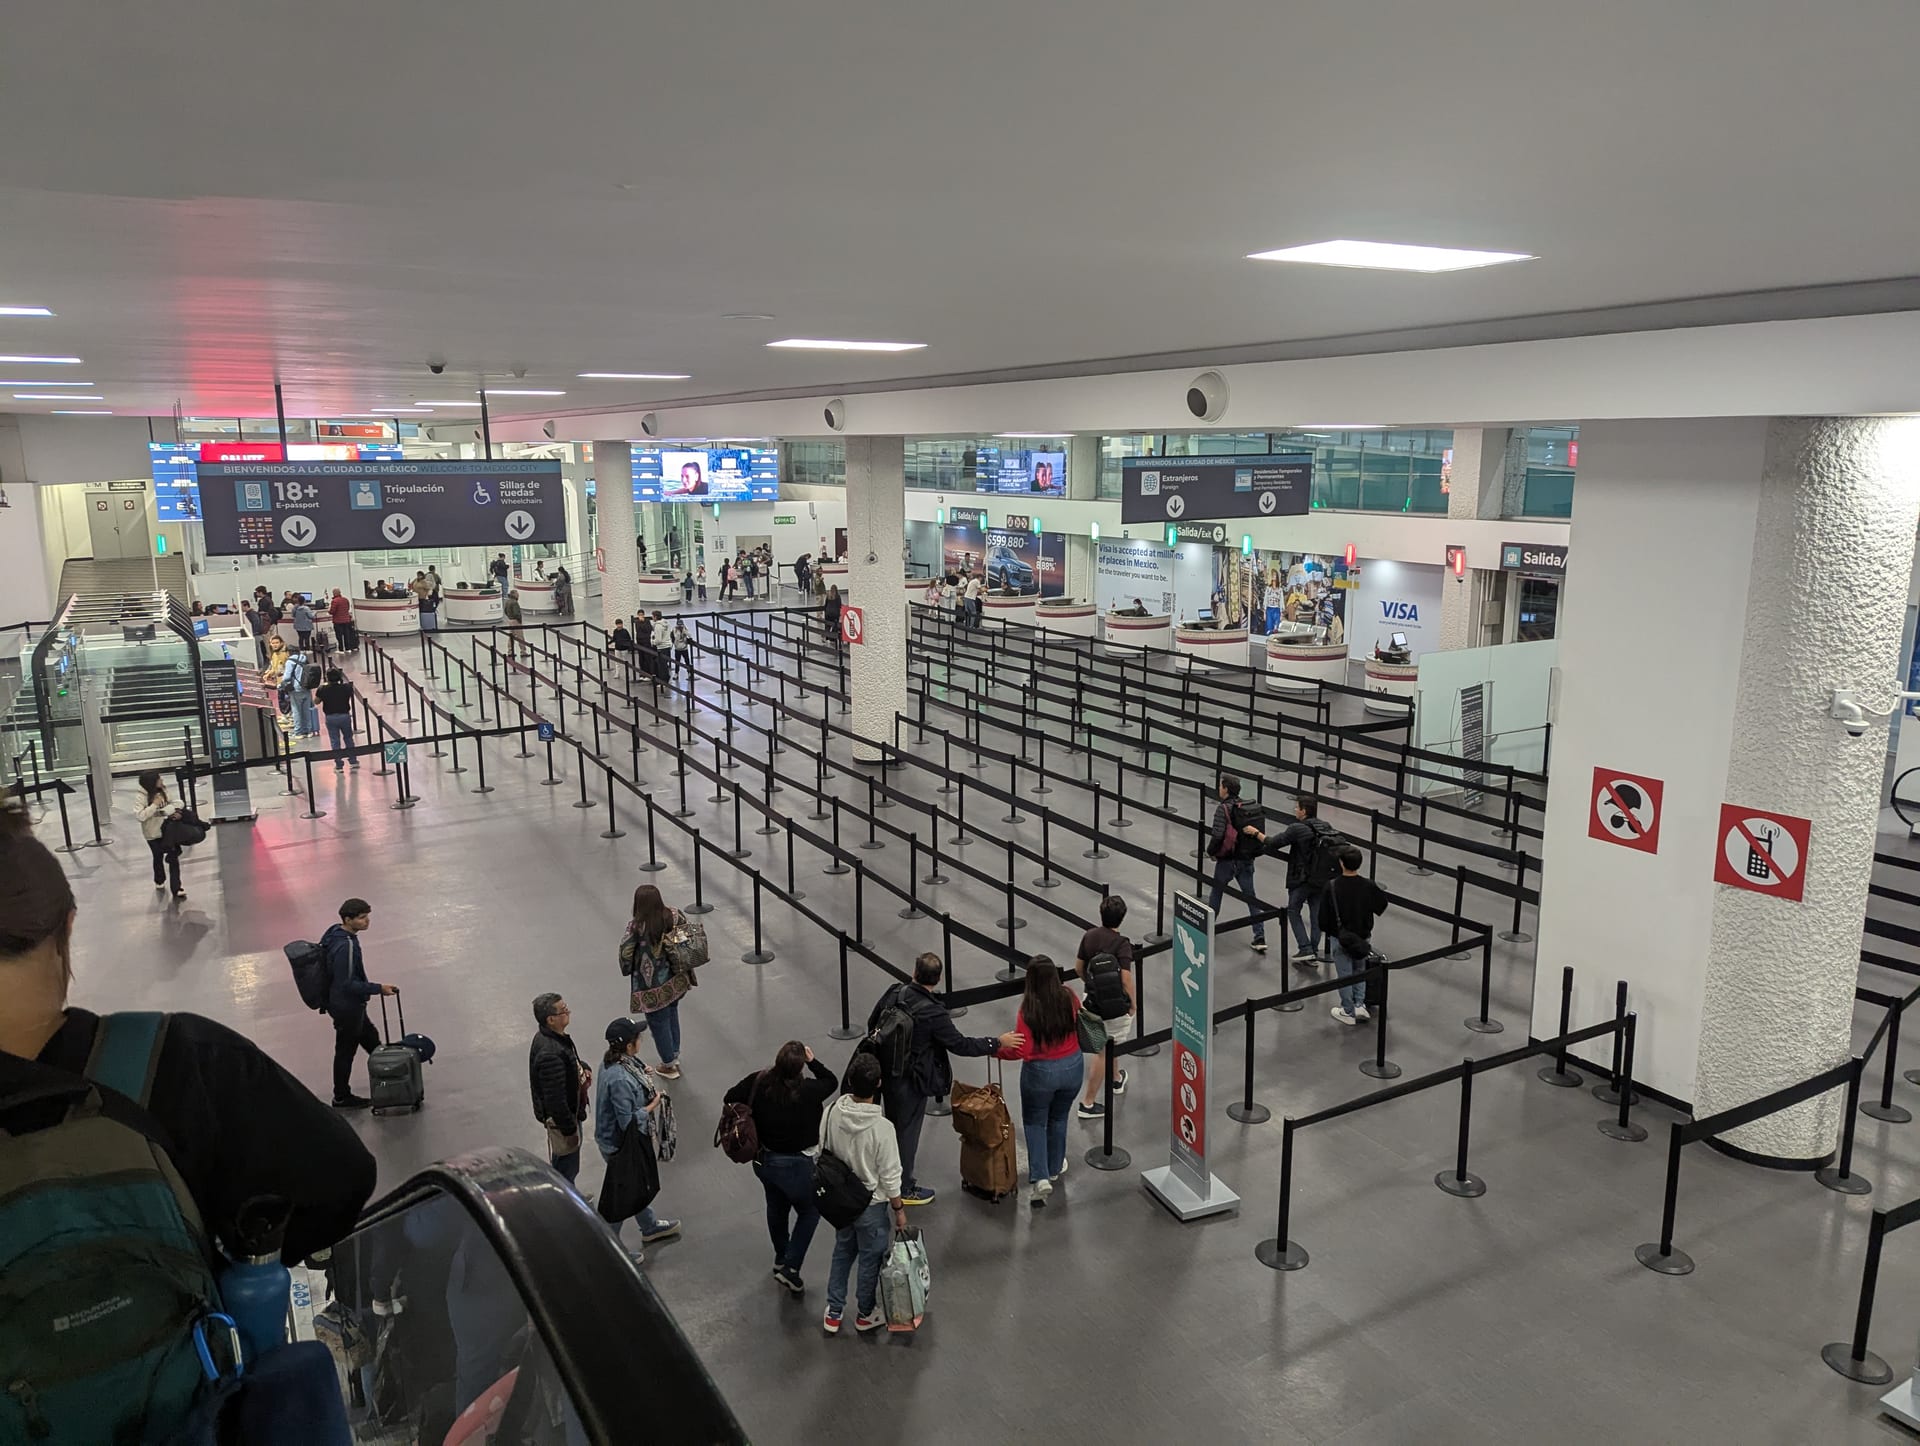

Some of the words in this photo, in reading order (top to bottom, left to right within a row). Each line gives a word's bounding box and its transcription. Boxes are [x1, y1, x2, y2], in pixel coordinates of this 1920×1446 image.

[223, 465, 296, 474] BIENVENIDOS
[298, 465, 306, 473] A
[308, 465, 321, 473] LA
[323, 465, 362, 473] CIUDAD
[365, 465, 379, 473] DE
[380, 463, 418, 473] MÉXICO
[421, 464, 468, 473] WELCOME
[469, 464, 481, 472] TO
[483, 463, 518, 472] MEXICO
[520, 463, 538, 472] CITY
[1162, 474, 1199, 483] Extranjeros
[384, 484, 444, 495] Tripulación
[500, 481, 525, 489] Sillas
[527, 481, 540, 489] de
[274, 482, 319, 501] 18+
[500, 488, 535, 497] ruedas
[385, 496, 406, 504] Crew
[275, 502, 320, 510] E-passport
[1177, 526, 1212, 539] Salida/Exit
[1099, 544, 1112, 553] Visa
[1112, 546, 1118, 554] is
[1118, 546, 1148, 558] accepted
[1149, 549, 1156, 557] at
[1105, 556, 1126, 567] places
[1126, 558, 1133, 566] in
[1133, 560, 1159, 570] Mexico.
[1098, 567, 1105, 575] Be
[1105, 568, 1113, 576] the
[1113, 570, 1131, 578] traveler
[1131, 572, 1141, 581] you
[1141, 573, 1153, 581] want
[1160, 574, 1169, 582] be.
[1380, 600, 1418, 621] VISA
[216, 749, 240, 760] 18+
[1177, 897, 1206, 920] Mexicanos
[70, 1296, 120, 1320] MOUNTAIN
